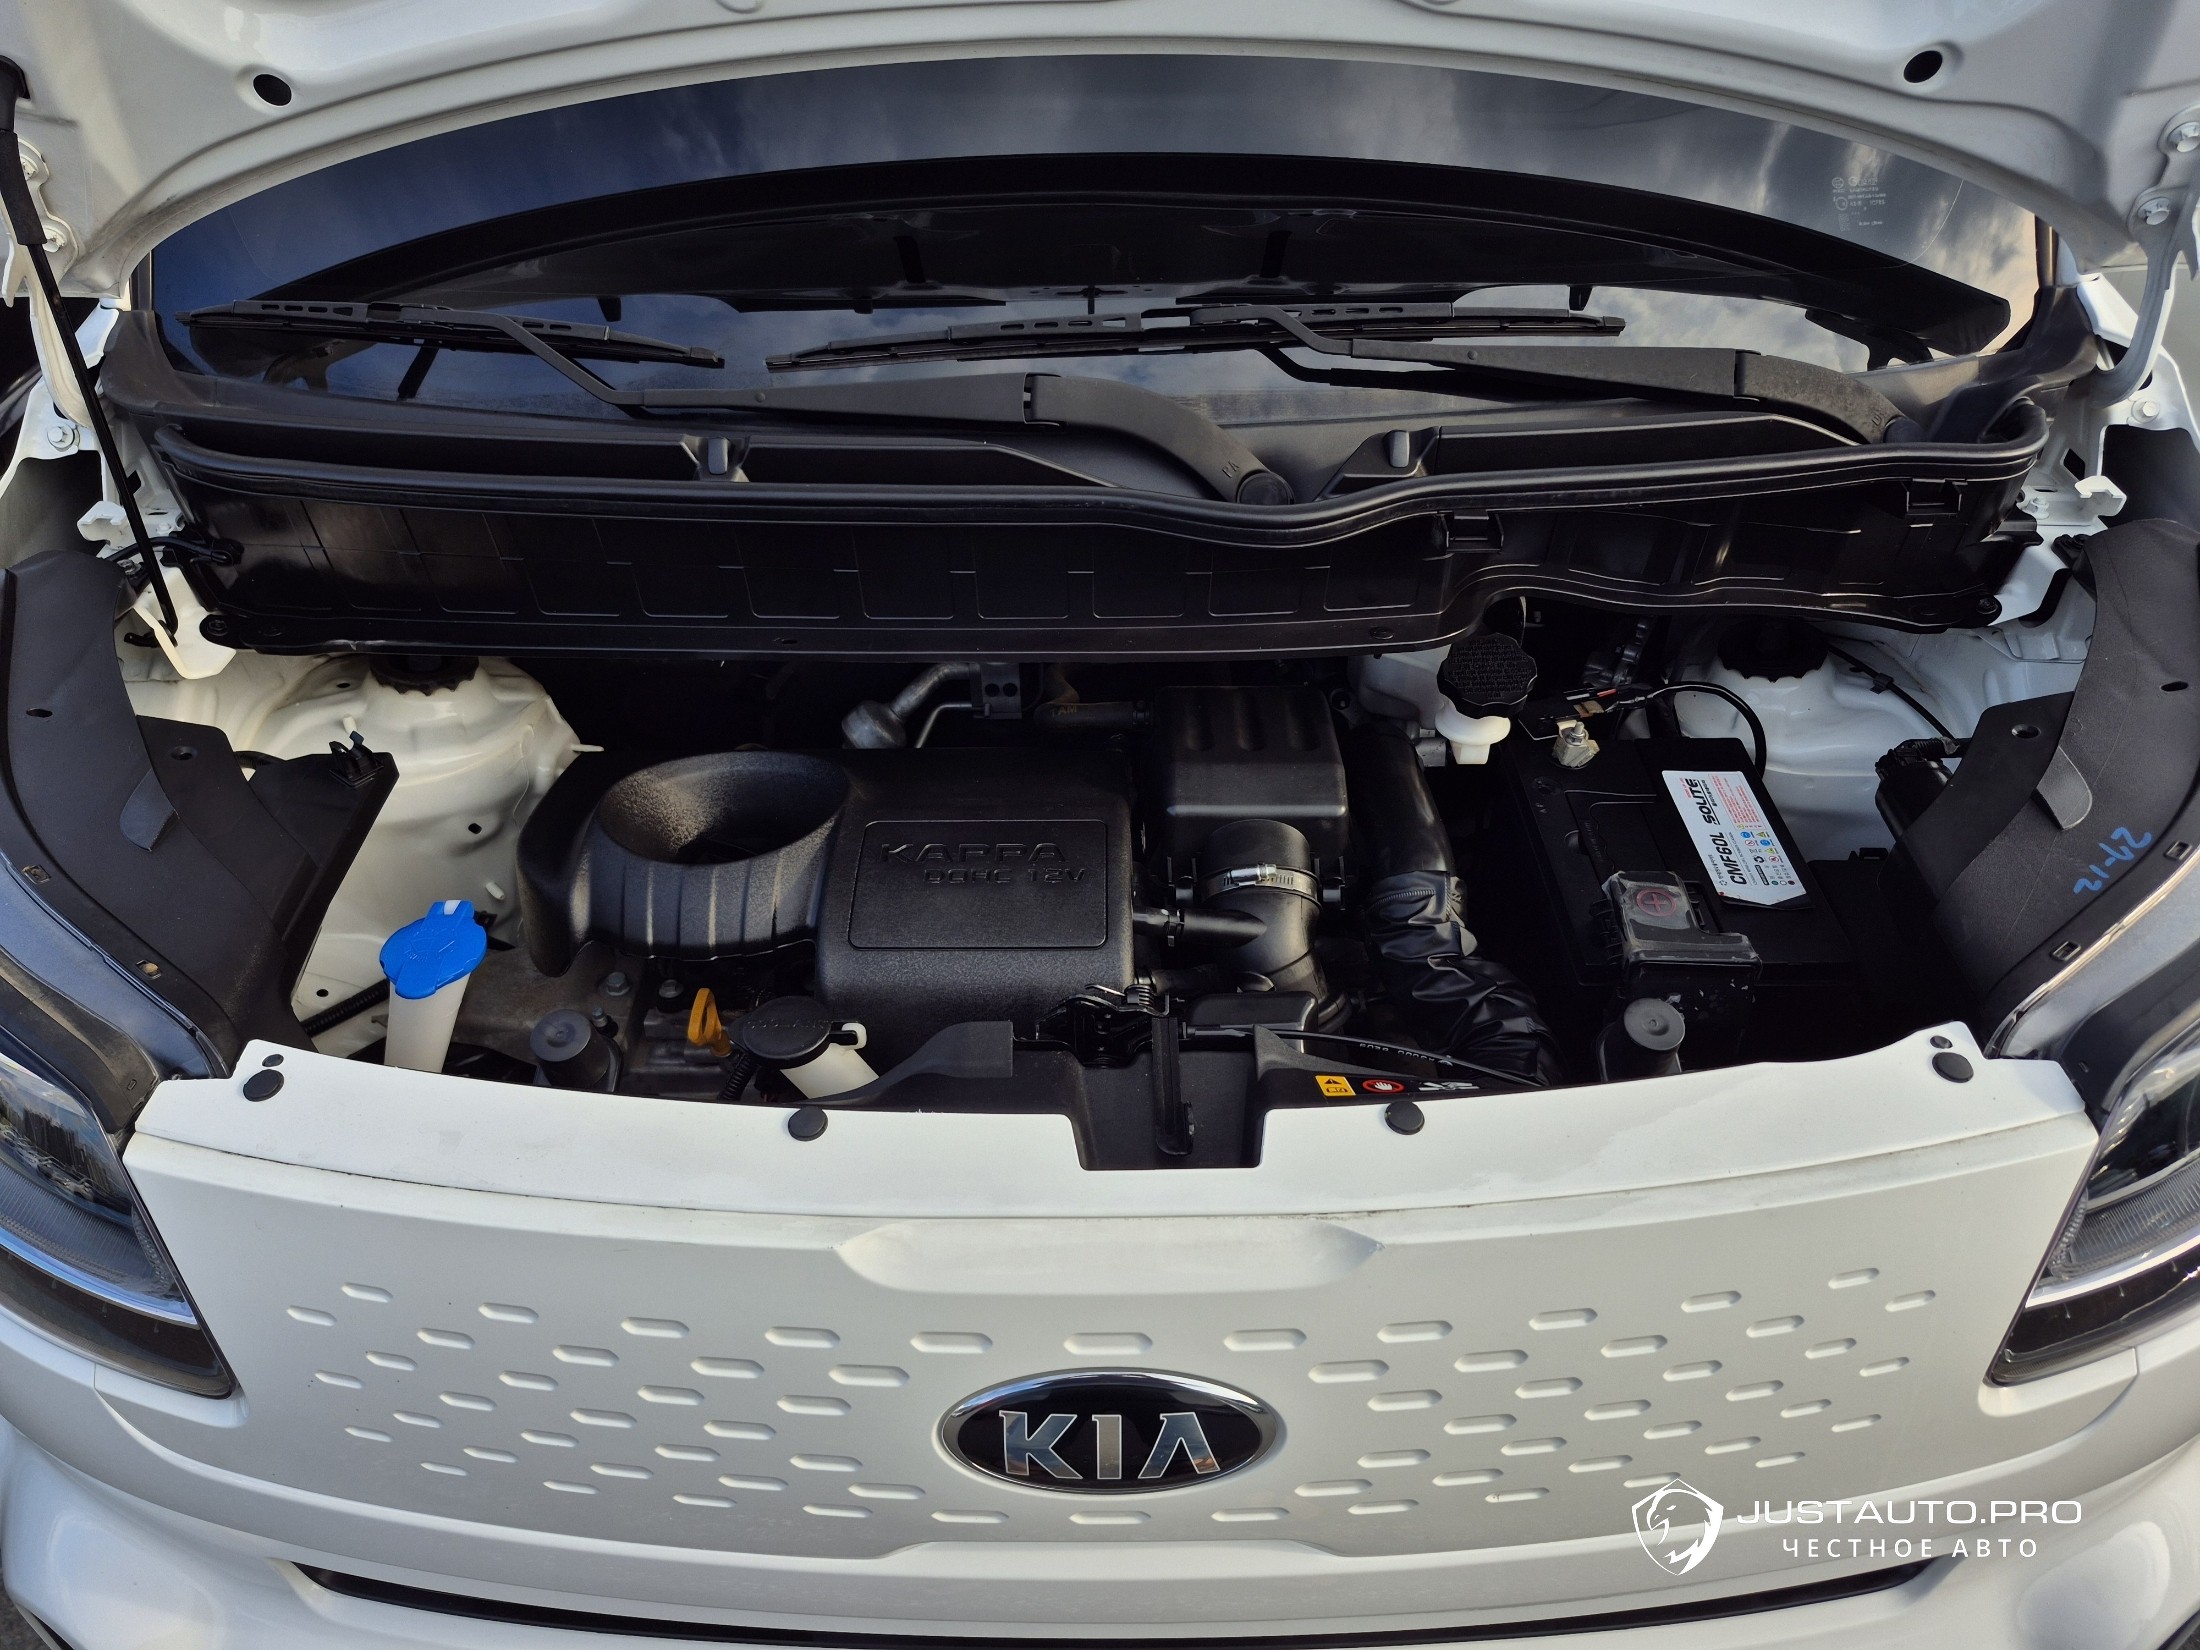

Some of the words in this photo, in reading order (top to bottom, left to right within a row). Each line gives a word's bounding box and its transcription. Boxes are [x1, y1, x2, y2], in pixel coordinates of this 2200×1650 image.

[1684, 778, 1717, 826] SOLITE
[880, 842, 1067, 863] KAPPA
[923, 868, 1012, 884] DOHC
[1027, 868, 1086, 884] 12V
[1709, 831, 1748, 885] CMF60L
[999, 1410, 1220, 1479] KIA
